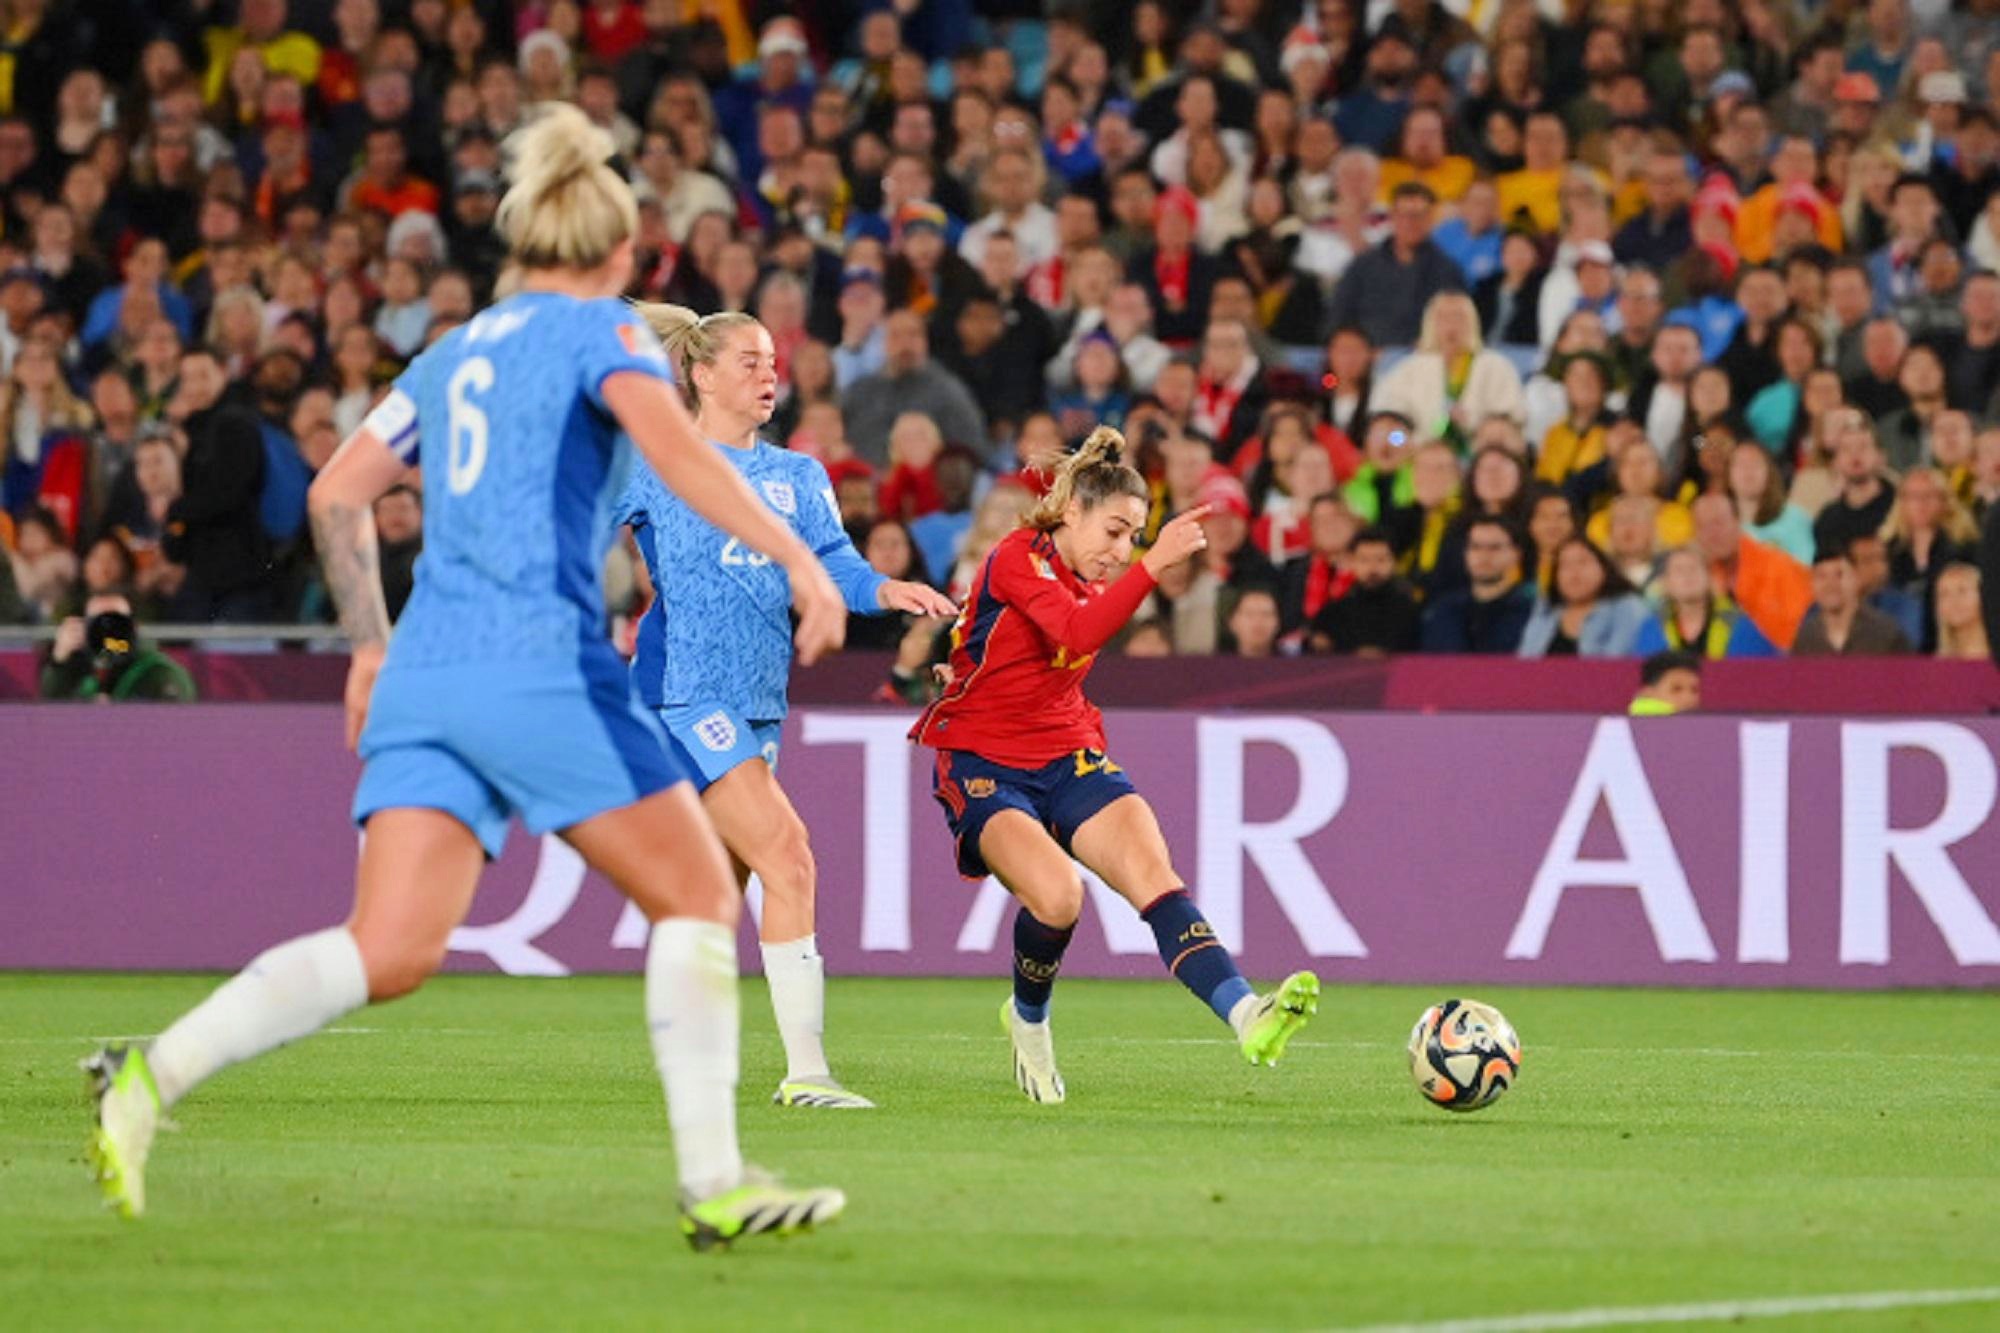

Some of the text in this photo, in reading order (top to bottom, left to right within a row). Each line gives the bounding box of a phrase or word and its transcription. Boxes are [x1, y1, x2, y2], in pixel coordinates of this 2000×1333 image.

[448, 356, 494, 495] 6
[721, 535, 770, 567] 2
[1503, 716, 2000, 966] AIR
